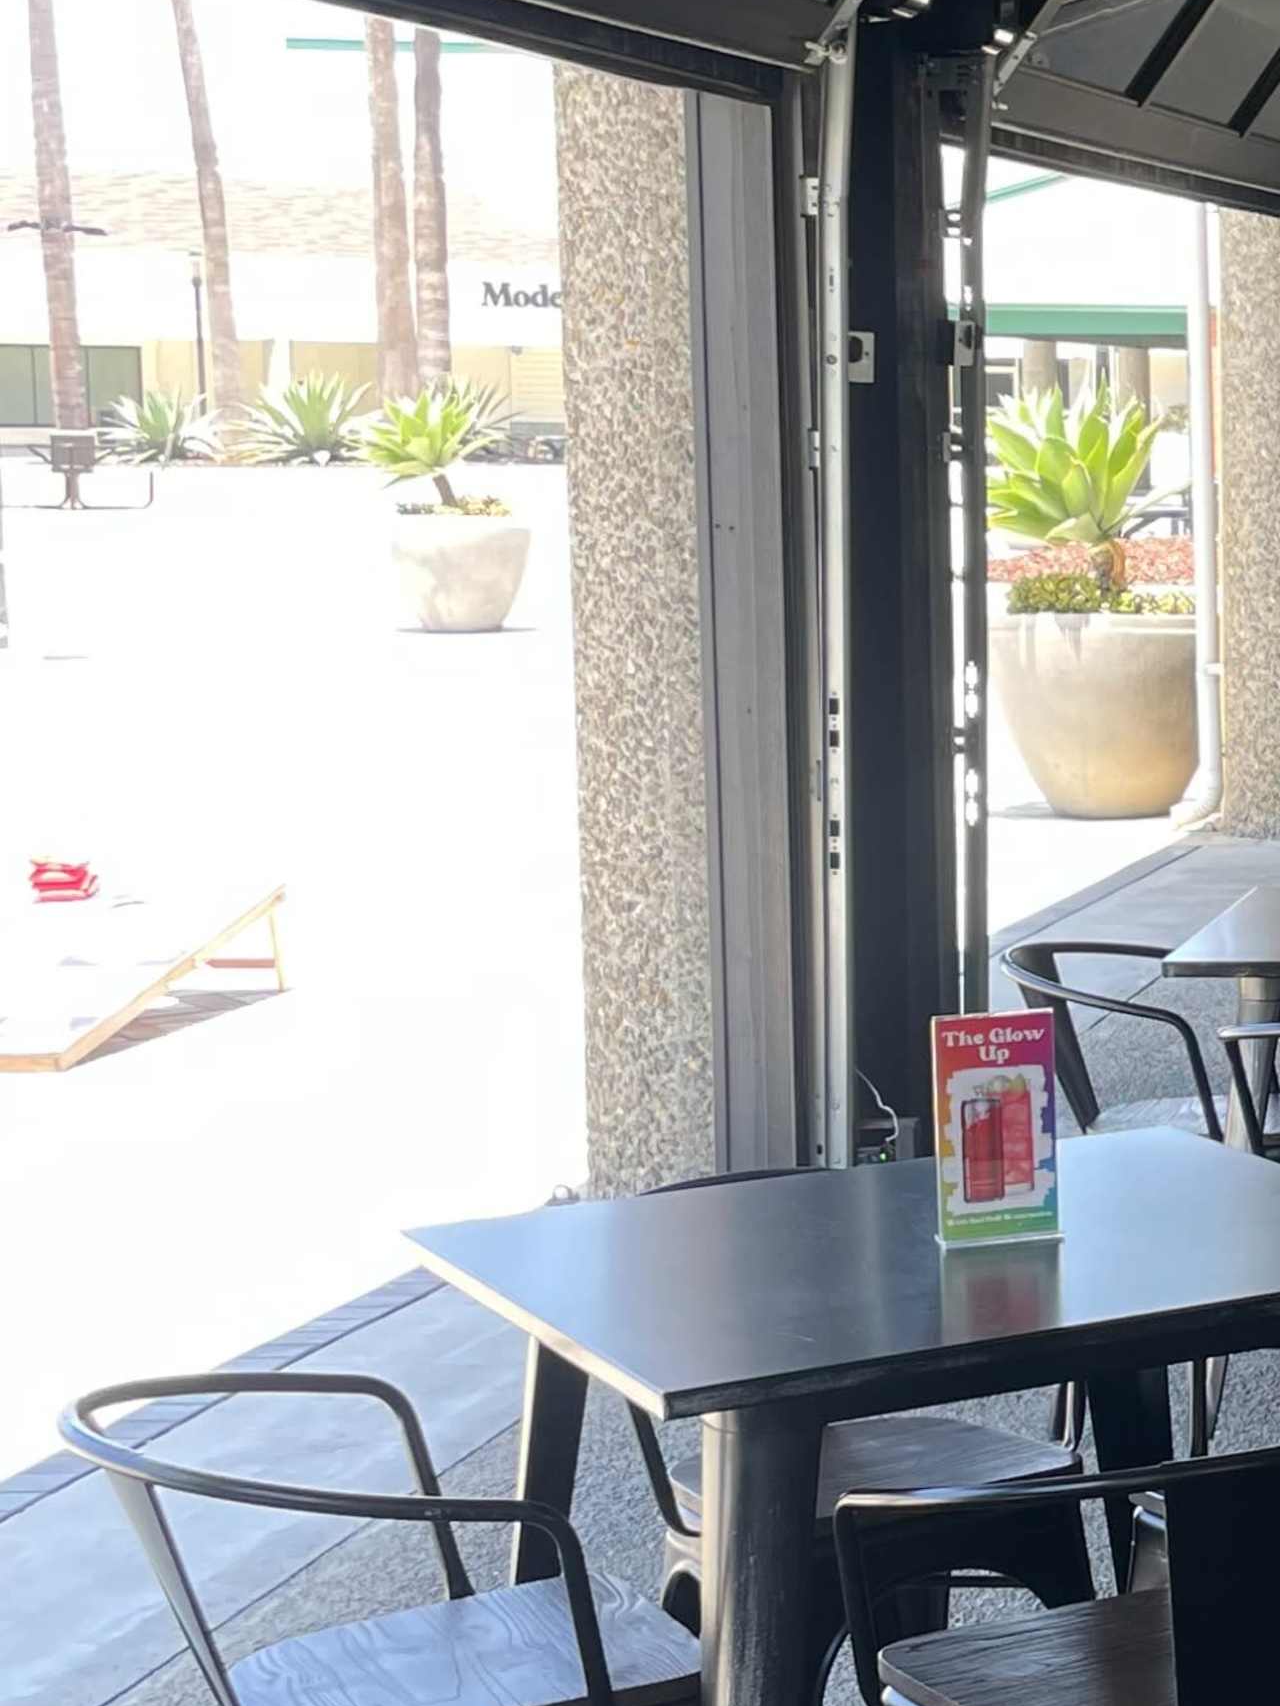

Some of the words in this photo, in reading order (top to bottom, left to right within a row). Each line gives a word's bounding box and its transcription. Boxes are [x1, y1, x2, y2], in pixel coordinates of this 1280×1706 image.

[942, 1030, 985, 1047] The
[989, 1027, 1046, 1044] Glow
[978, 1044, 1010, 1064] Up
